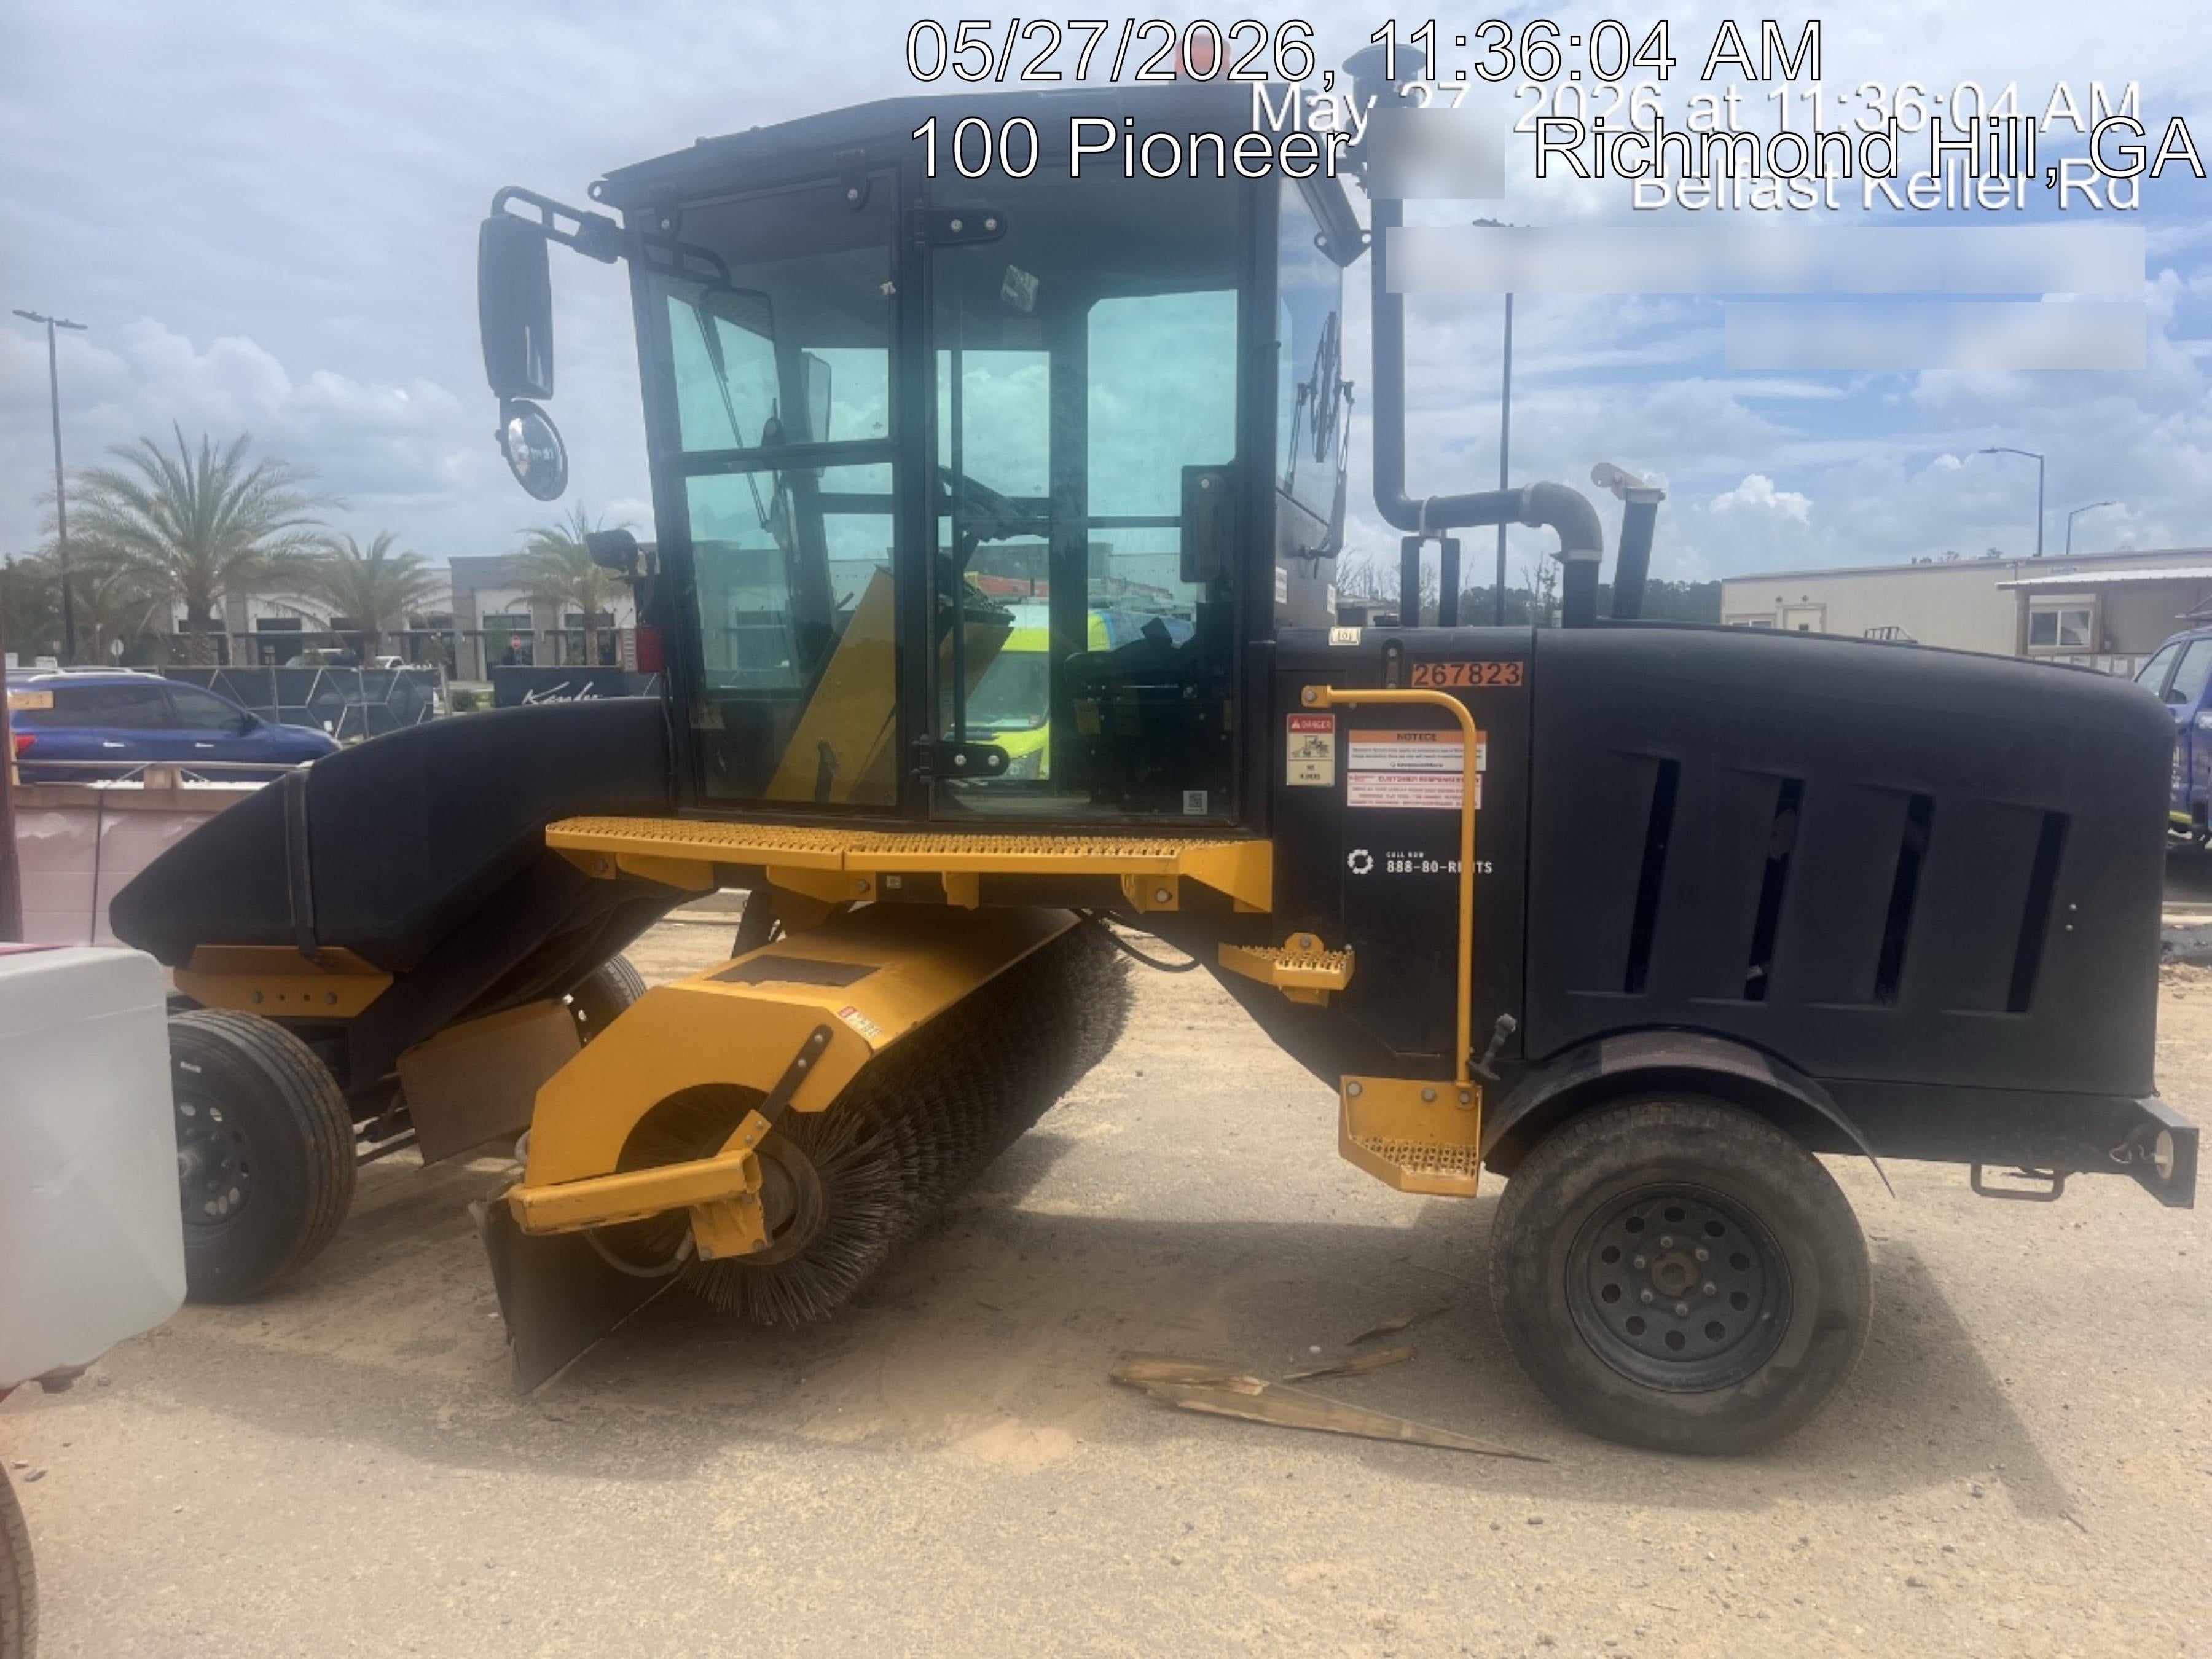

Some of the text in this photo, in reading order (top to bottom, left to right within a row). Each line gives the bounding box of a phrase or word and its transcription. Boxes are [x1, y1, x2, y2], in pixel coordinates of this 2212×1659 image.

[1414, 663, 1520, 686] 267823
[1301, 720, 1332, 729] DANGER
[1387, 860, 1492, 874] 888-80-RTS
